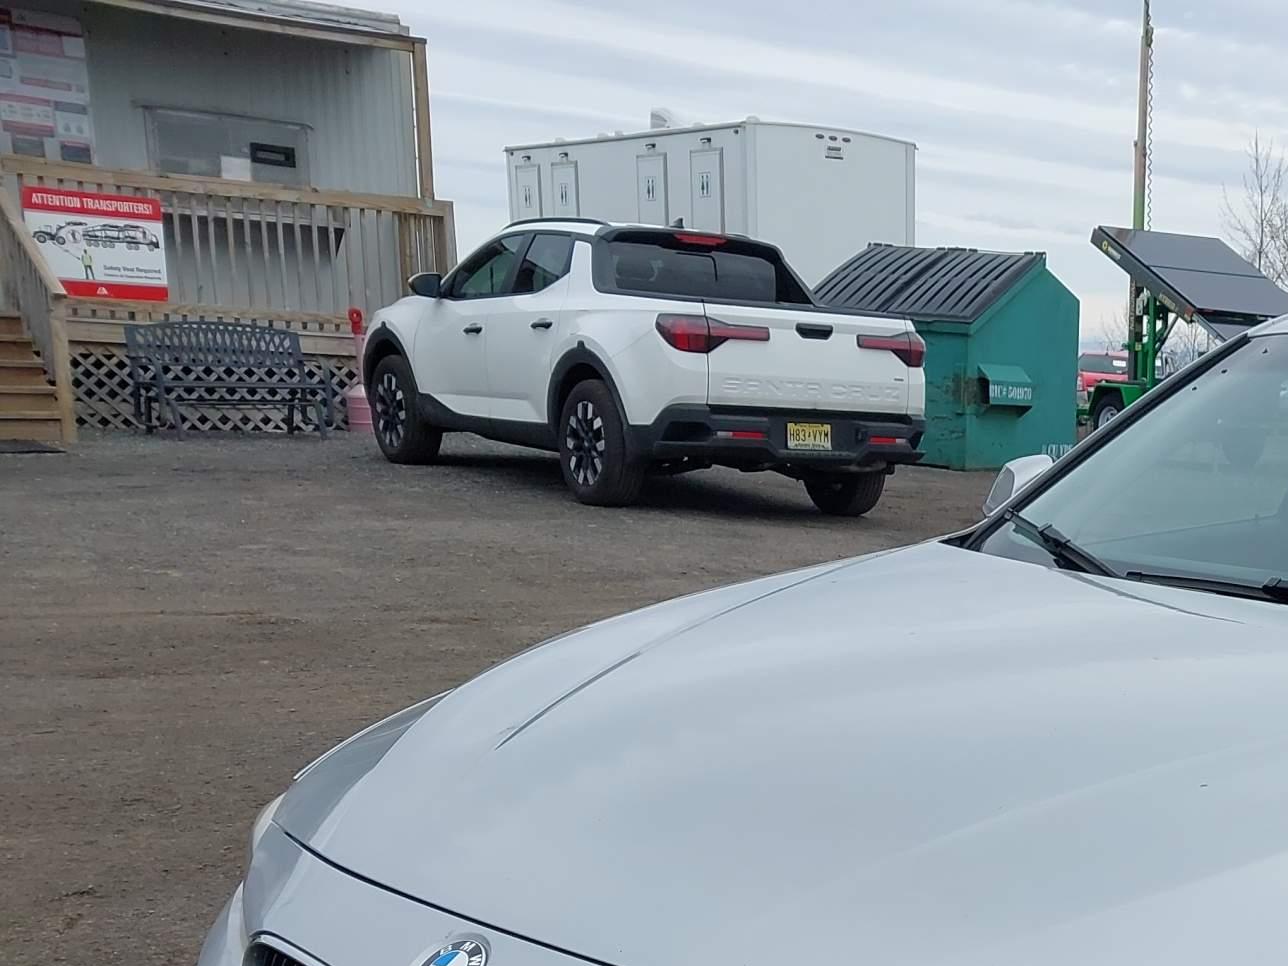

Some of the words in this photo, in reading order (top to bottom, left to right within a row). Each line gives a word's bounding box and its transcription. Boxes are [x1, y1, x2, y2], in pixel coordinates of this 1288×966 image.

[31, 193, 80, 208] ATTENTION
[81, 198, 153, 215] TRANSPORTERS!
[721, 377, 824, 399] SANTA
[830, 382, 900, 402] CRUZ
